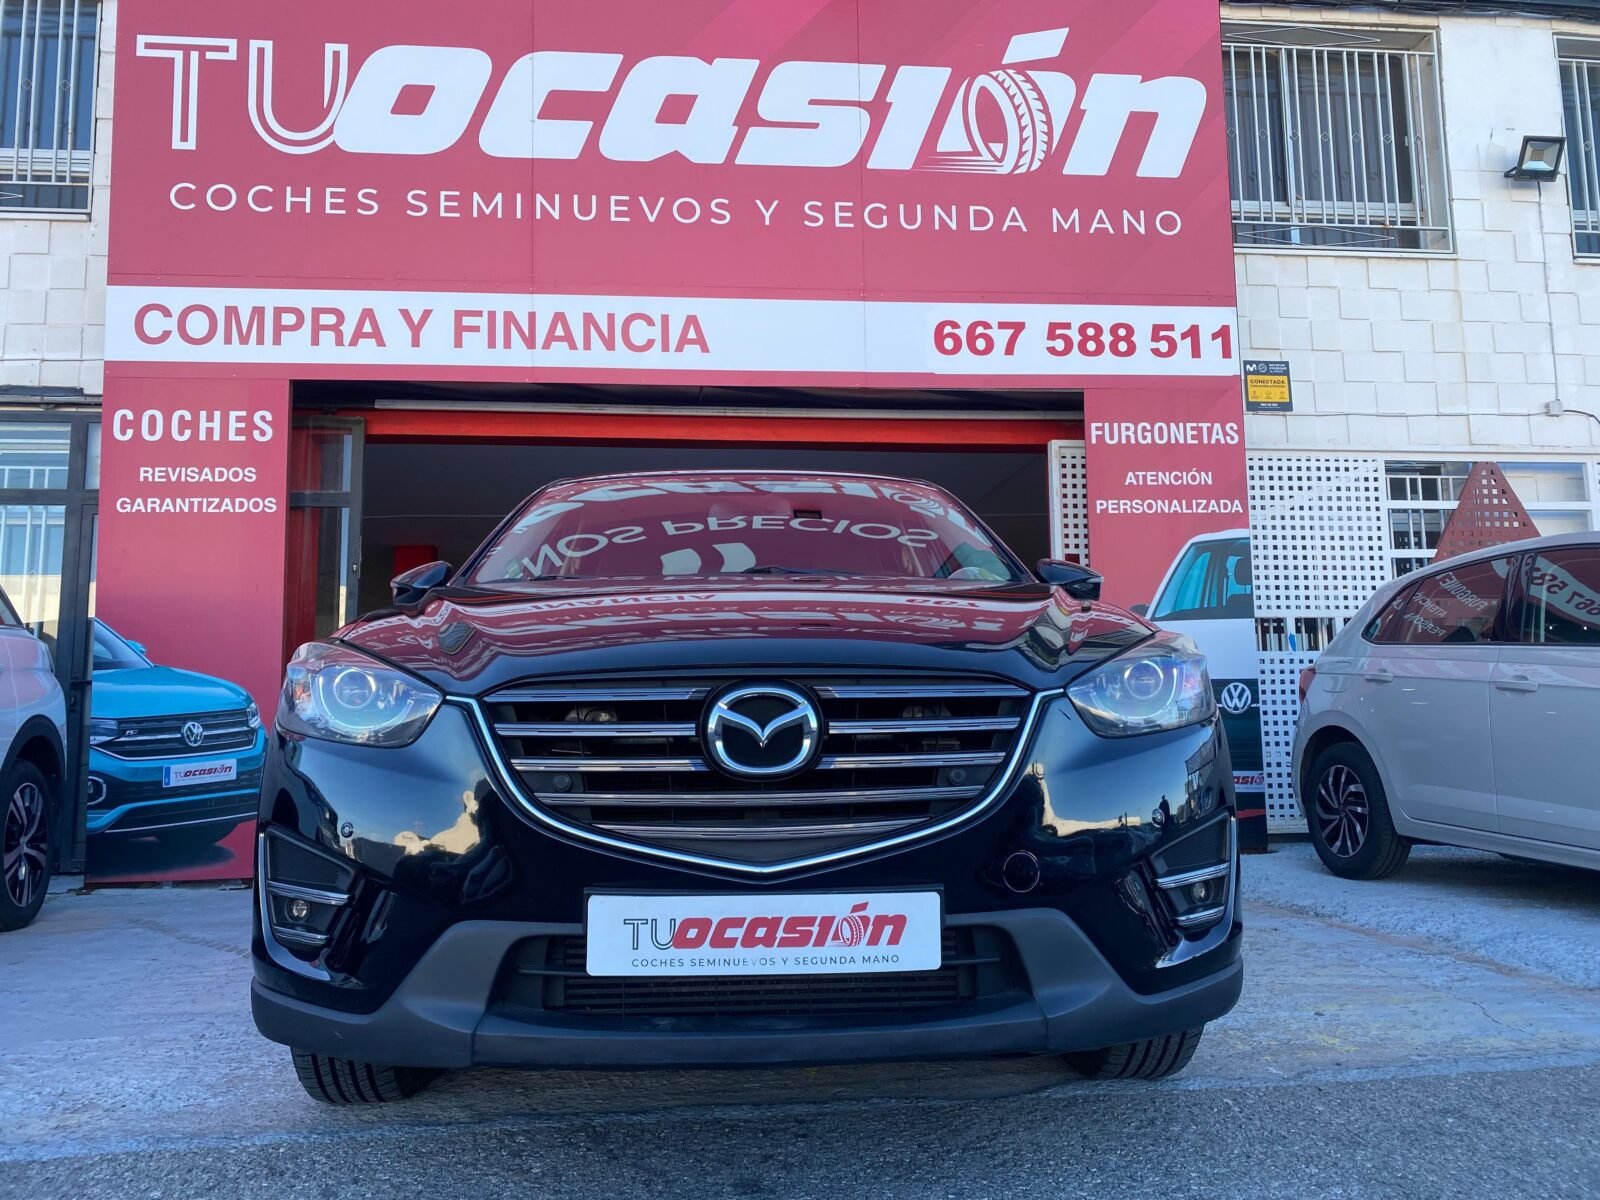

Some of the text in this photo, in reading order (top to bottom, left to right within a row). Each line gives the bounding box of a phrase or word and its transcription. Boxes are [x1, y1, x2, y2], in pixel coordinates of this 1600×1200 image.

[169, 182, 1182, 236] COCHES SEMINUEVOS Y SEGUNDA MANO
[135, 303, 709, 353] COMPRA Y FINANCIA
[933, 319, 1232, 359] 667 588 511
[112, 408, 273, 442] COCHES
[1090, 422, 1239, 445] FURGONETAS
[139, 466, 257, 483] REVISADOS
[1124, 468, 1213, 486] ATENCIÓN
[116, 497, 277, 513] GARANTIZADOS
[1096, 499, 1244, 514] PERSONALIZADA
[631, 953, 900, 968] COCHES SEMINUEVOS Y SEGUNDA MANO
